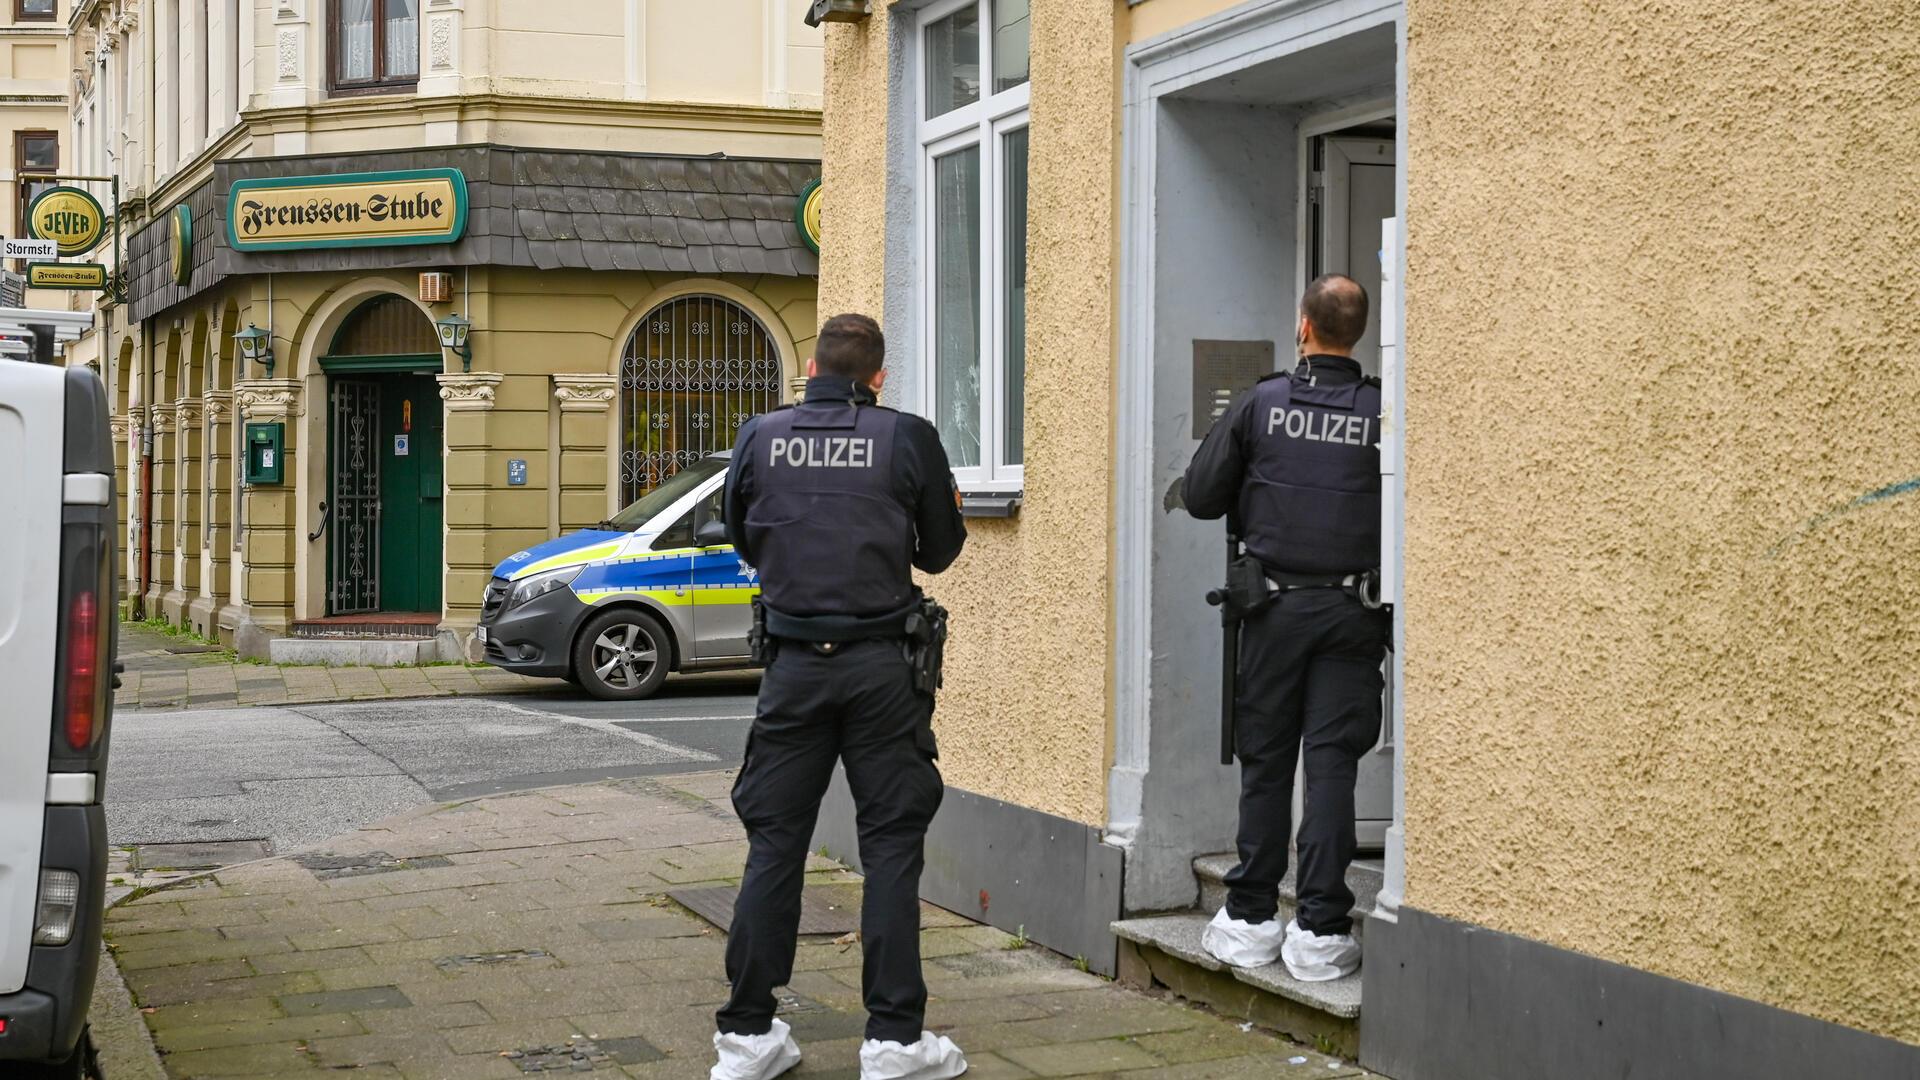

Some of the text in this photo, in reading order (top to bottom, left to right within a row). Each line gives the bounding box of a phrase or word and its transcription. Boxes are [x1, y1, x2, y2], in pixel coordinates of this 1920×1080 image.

[43, 211, 90, 235] JEVER
[241, 191, 443, 235] Frenssen-Stube
[6, 242, 54, 256] Stormstr.
[1267, 407, 1370, 446] POLIZEI
[769, 437, 874, 468] POLIZEI
